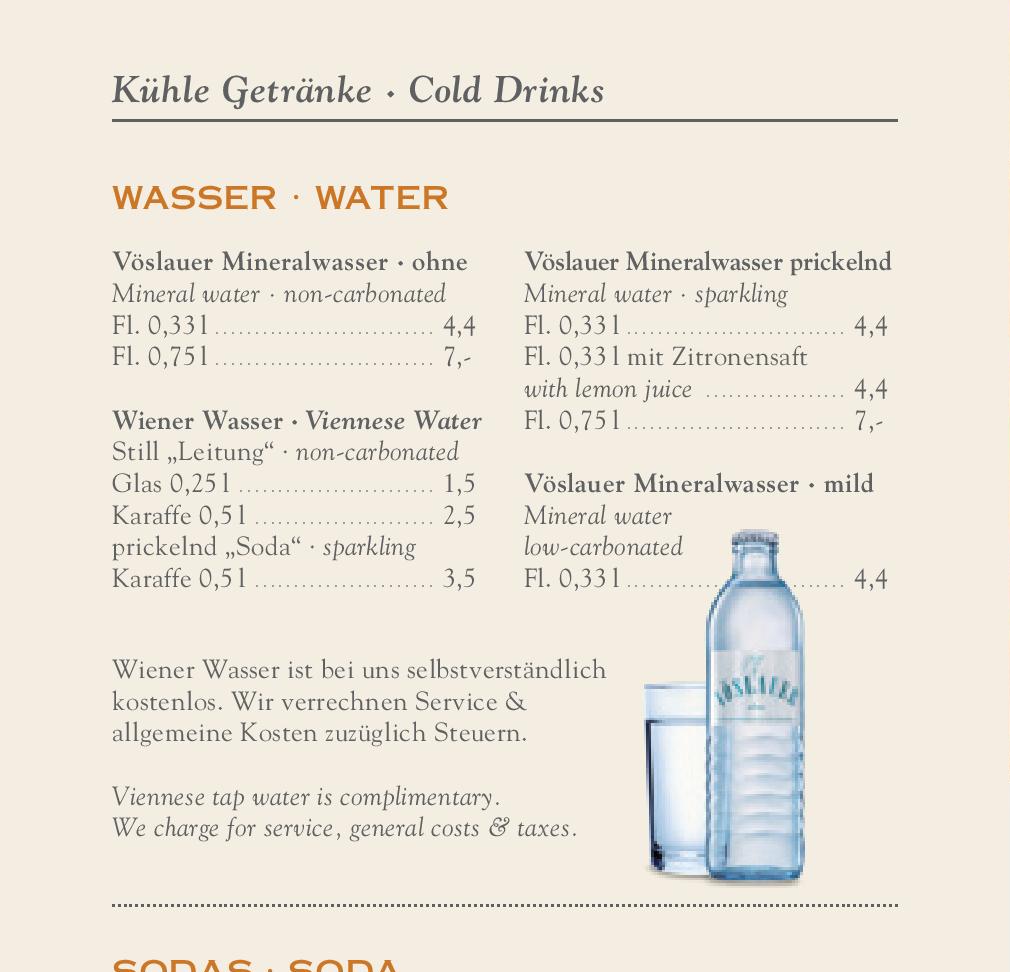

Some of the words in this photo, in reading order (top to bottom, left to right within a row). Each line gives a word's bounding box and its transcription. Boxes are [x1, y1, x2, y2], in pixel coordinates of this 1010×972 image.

[112, 75, 209, 103] Kühle
[223, 75, 371, 110] Getränke
[410, 75, 482, 103] Cold
[493, 75, 604, 103] Drinks
[112, 185, 276, 210] WASSER
[315, 185, 448, 209] WATER
[112, 250, 214, 271] Vöslauer
[222, 250, 388, 271] Mineralwasser
[412, 250, 467, 271] ohne
[525, 250, 619, 271] Vöslauer
[626, 250, 783, 271] Mineralwasser
[790, 250, 892, 276] prickelnd
[112, 282, 195, 303] Mineral
[201, 288, 260, 303] water
[284, 282, 446, 303] non-carbonated
[524, 282, 606, 303] Mineral
[614, 288, 672, 303] water
[695, 282, 788, 308] sparkling
[112, 314, 139, 334] Fl.
[443, 315, 475, 339] 4,4
[525, 314, 550, 334] Fl.
[854, 315, 888, 338] 4,4
[112, 345, 139, 365] Fl.
[525, 345, 550, 365] Fl.
[628, 348, 664, 366] mit
[672, 345, 808, 366] Zitronensaft
[524, 377, 568, 399] with
[576, 377, 637, 399] lemon
[643, 379, 691, 403] juice
[854, 378, 887, 402] 4,4
[112, 410, 194, 431] Wiener
[202, 410, 283, 430] Wasser
[305, 410, 405, 430] Viennese
[414, 410, 482, 430] Water
[525, 409, 550, 429] Fl.
[113, 440, 159, 461] Still
[296, 440, 459, 463] non-carbonated
[112, 472, 161, 493] Glas
[445, 473, 474, 496] 1,5
[525, 472, 625, 493] Vöslauer
[633, 472, 799, 495] Mineralwasser
[824, 472, 874, 493] mild
[112, 504, 191, 525] Karaffe
[444, 505, 474, 528] 2,5
[524, 504, 606, 525] Mineral
[614, 510, 672, 527] water
[112, 535, 216, 561] prickelnd
[323, 535, 416, 561] sparkling
[525, 535, 683, 558] low-carbonated
[112, 567, 191, 588] Karaffe
[443, 568, 475, 591] 3,5
[524, 567, 550, 587] Fl.
[854, 568, 887, 591] 4,4
[112, 659, 195, 679] Wiener
[202, 659, 280, 679] Wasser
[288, 661, 312, 679] ist
[321, 658, 354, 679] bei
[362, 666, 399, 679] uns
[407, 658, 607, 679] selbstverständlich
[112, 690, 222, 711] kostenlos.
[231, 691, 274, 711] Wir
[281, 690, 408, 711] verrechnen
[416, 691, 497, 711] Service
[506, 691, 527, 711] &
[113, 721, 232, 747] allgemeine
[240, 722, 318, 742] Kosten
[325, 721, 427, 747] zuzüglich
[435, 722, 526, 742] Steuern.
[112, 786, 204, 806] Viennese
[213, 790, 244, 811] tap
[252, 792, 310, 806] water
[317, 787, 332, 806] is
[340, 785, 499, 811] complimentary.
[113, 817, 145, 837] We
[154, 816, 218, 842] charge
[225, 816, 256, 842] for
[264, 818, 340, 840] service,
[349, 816, 424, 842] general
[431, 822, 479, 839] costs
[489, 817, 510, 837] &
[518, 822, 576, 837] taxes.
